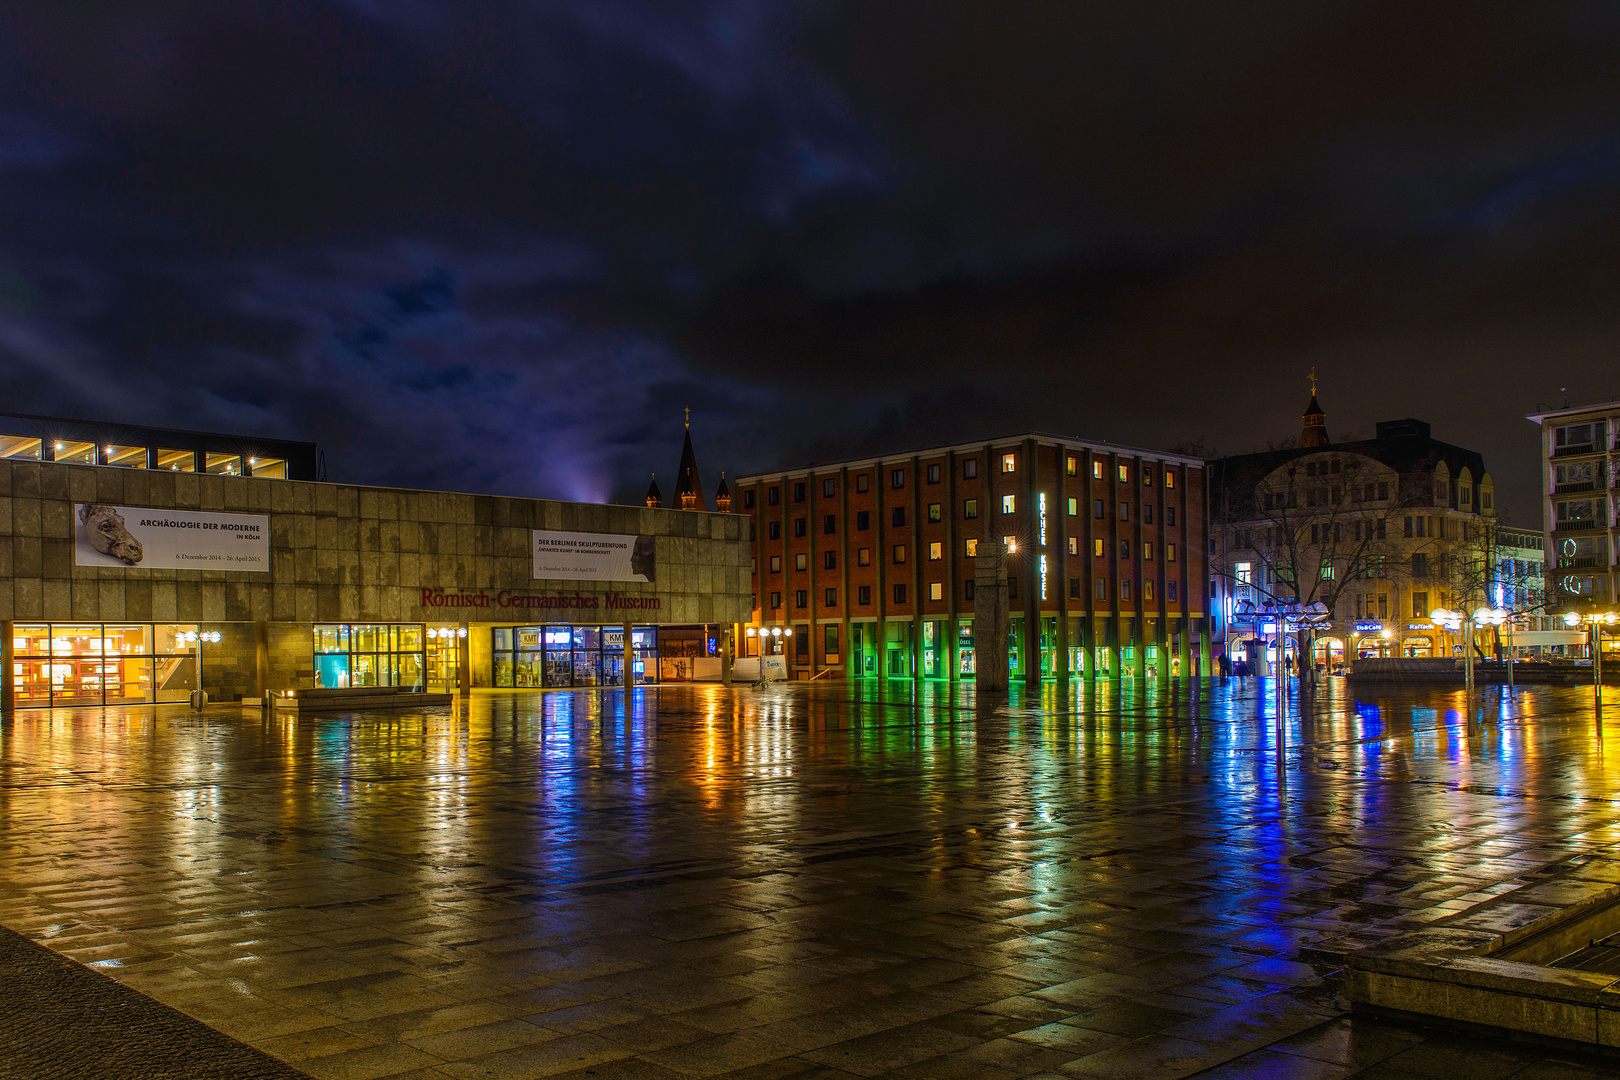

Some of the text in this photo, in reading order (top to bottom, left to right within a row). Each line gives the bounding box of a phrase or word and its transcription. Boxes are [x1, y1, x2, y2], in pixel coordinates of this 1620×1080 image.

[140, 519, 201, 529] ARCHÄOLOGIE
[220, 524, 260, 532] MODERNE
[578, 541, 628, 549] SKULPTURENFUND
[234, 555, 248, 563] April
[421, 588, 662, 609] Römisch-Germanisches Museum
